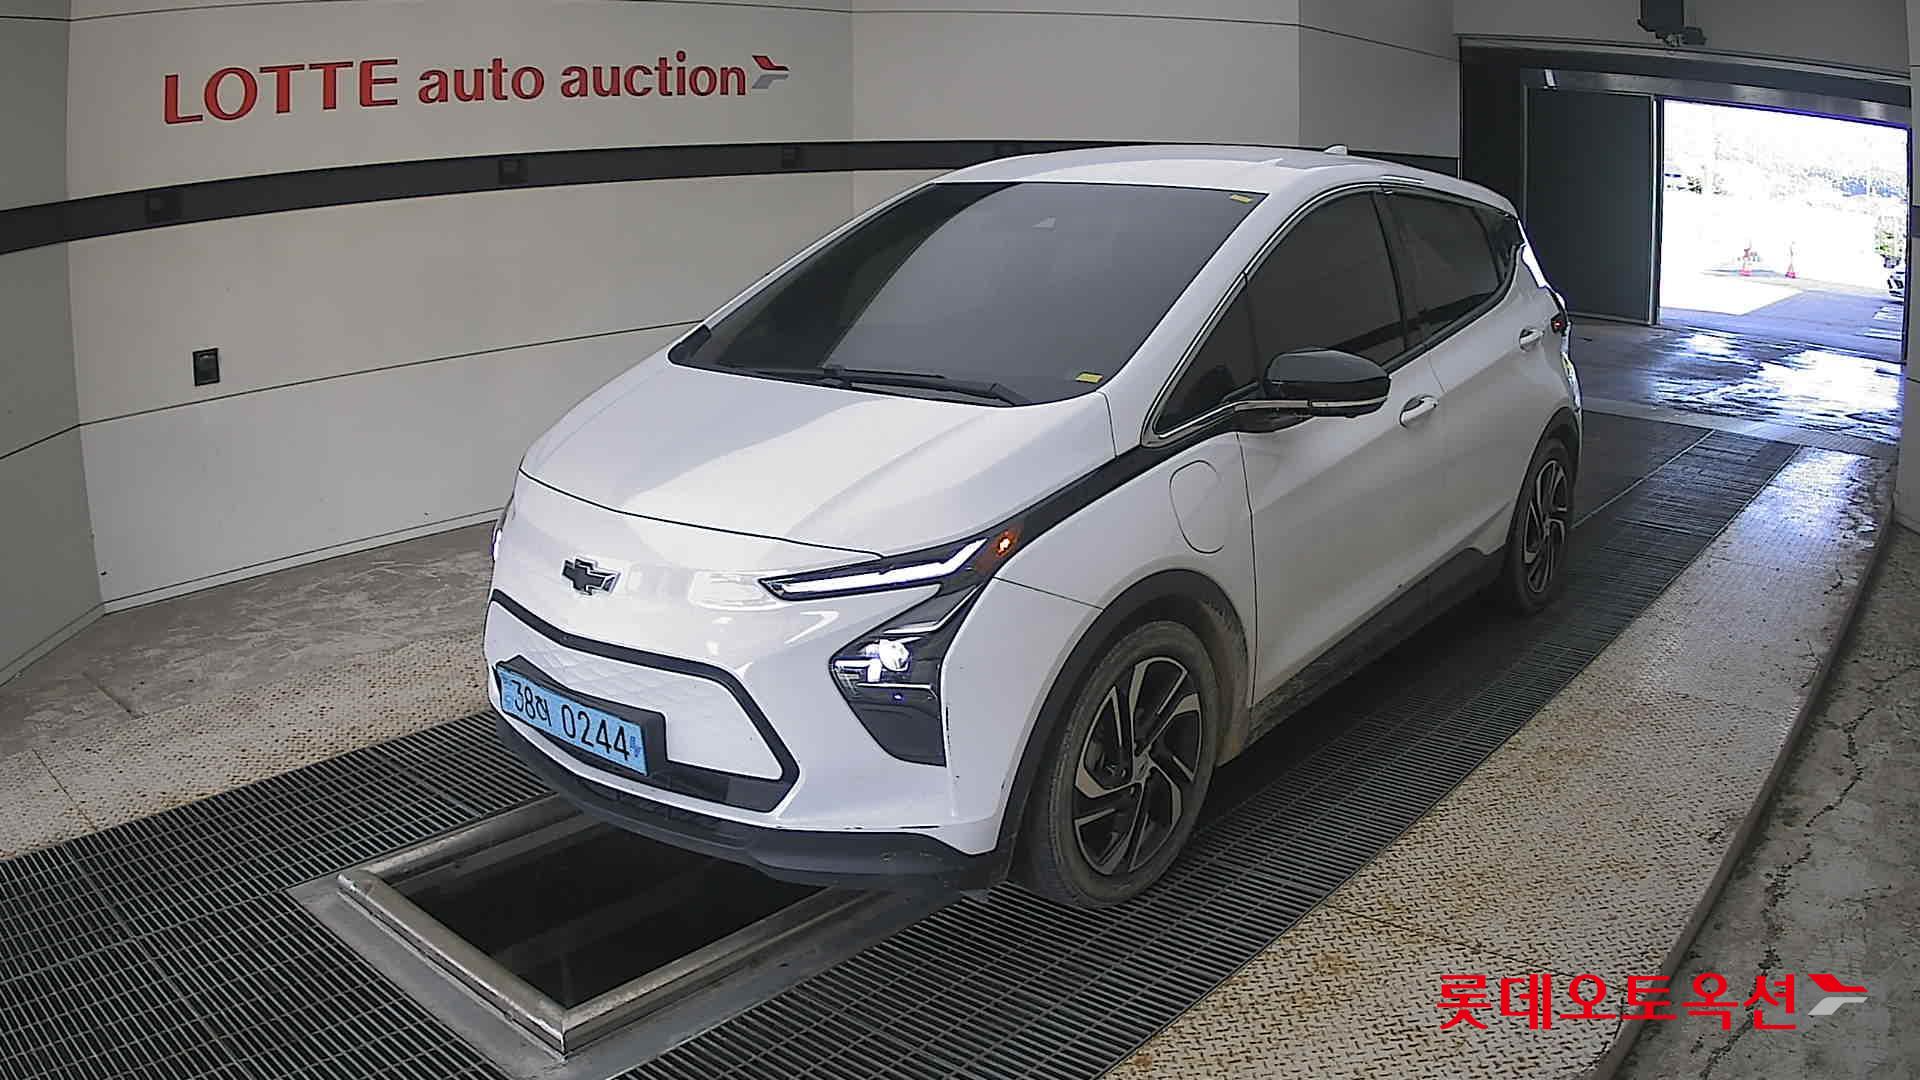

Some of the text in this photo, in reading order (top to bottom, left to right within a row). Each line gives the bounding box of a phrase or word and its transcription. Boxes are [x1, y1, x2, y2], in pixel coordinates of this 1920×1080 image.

[164, 50, 747, 125] LOTTE auto auction
[561, 704, 630, 762] 0244
